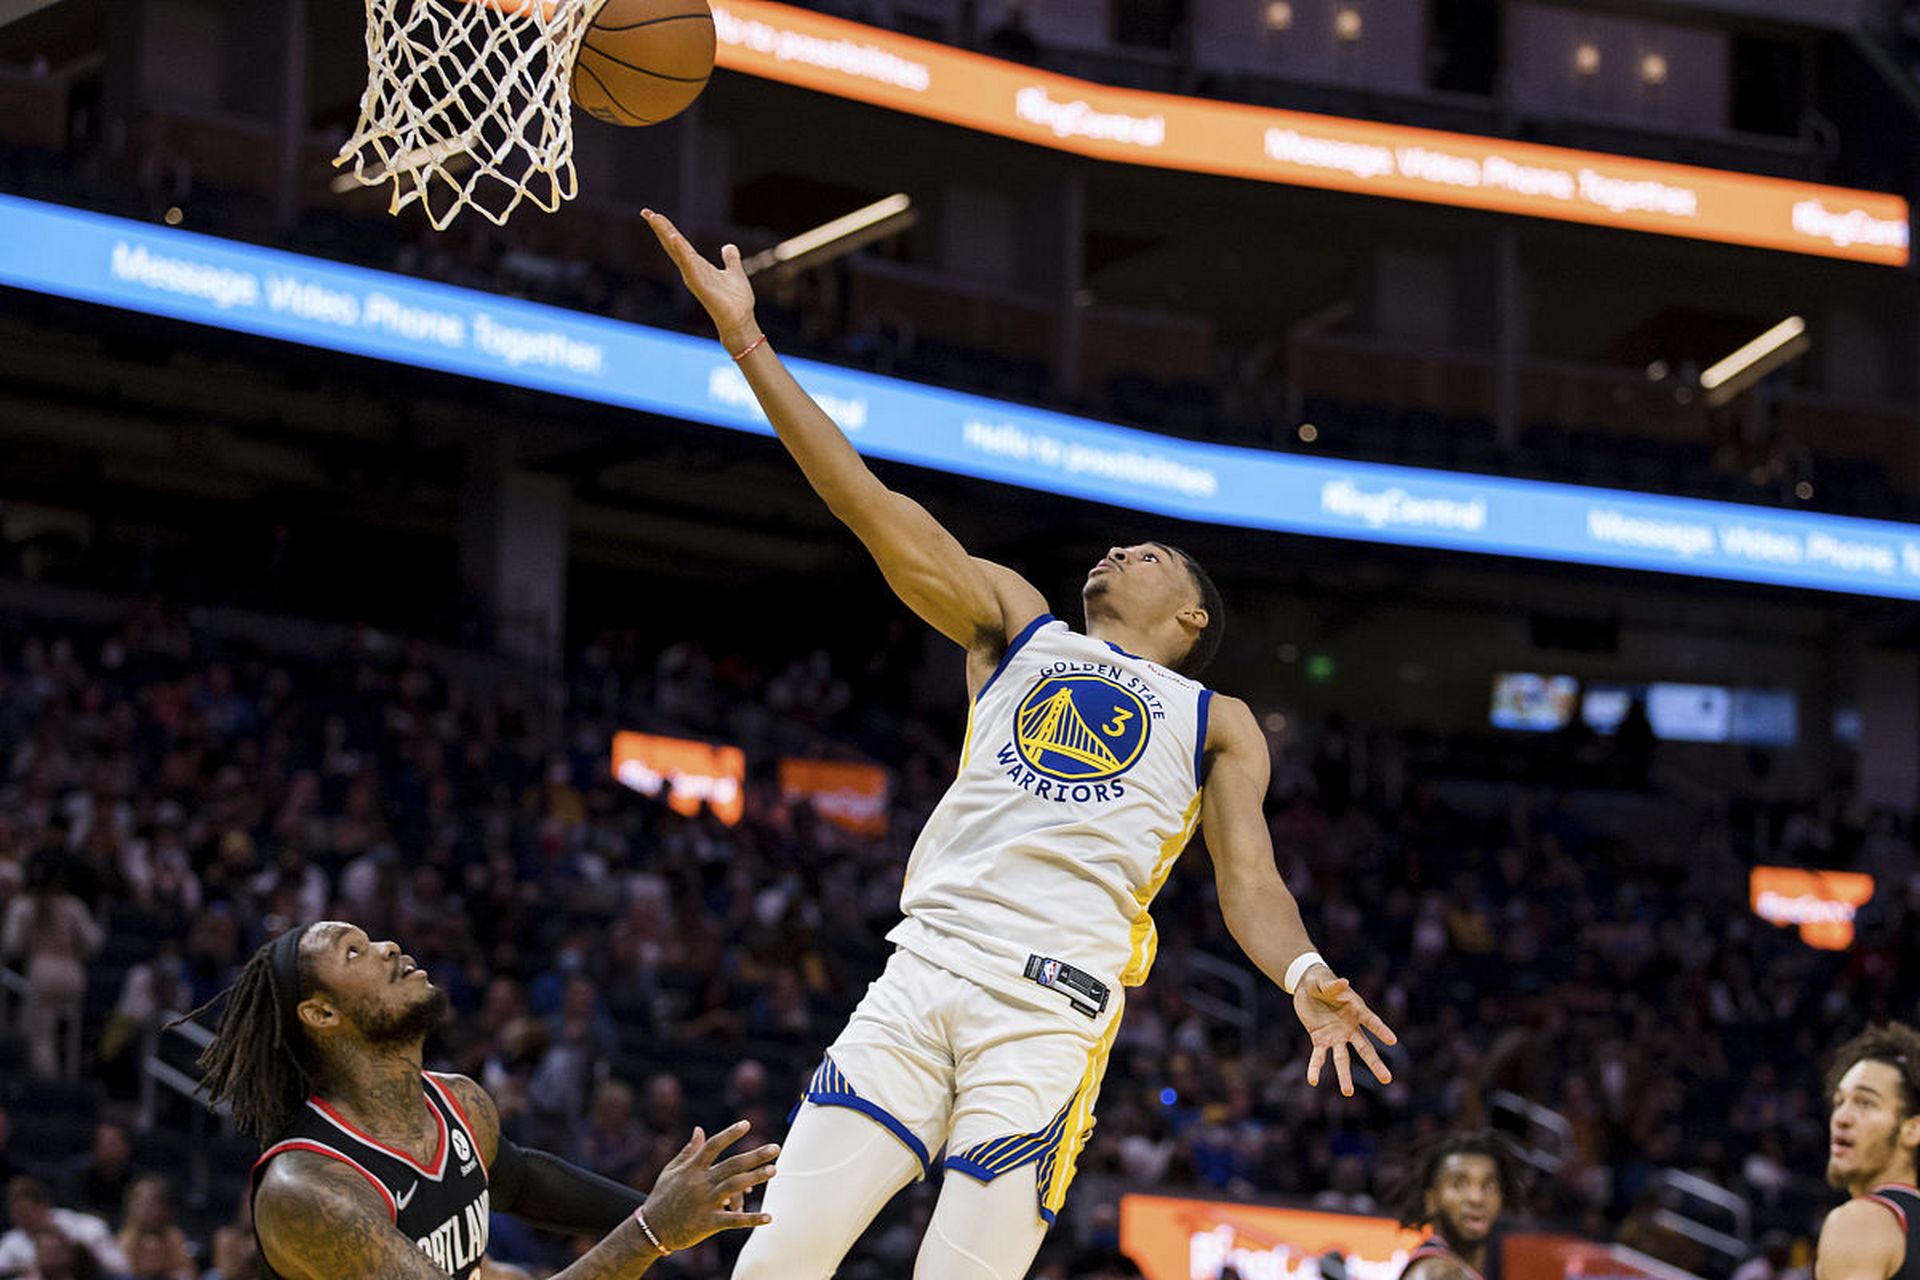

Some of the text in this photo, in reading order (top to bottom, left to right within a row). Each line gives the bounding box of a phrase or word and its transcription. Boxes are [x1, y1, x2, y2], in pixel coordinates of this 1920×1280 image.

[1040, 661, 1122, 680] GOLDEN
[1127, 677, 1166, 720] STATE
[1102, 705, 1134, 737] 3
[996, 741, 1126, 802] WARRIORS
